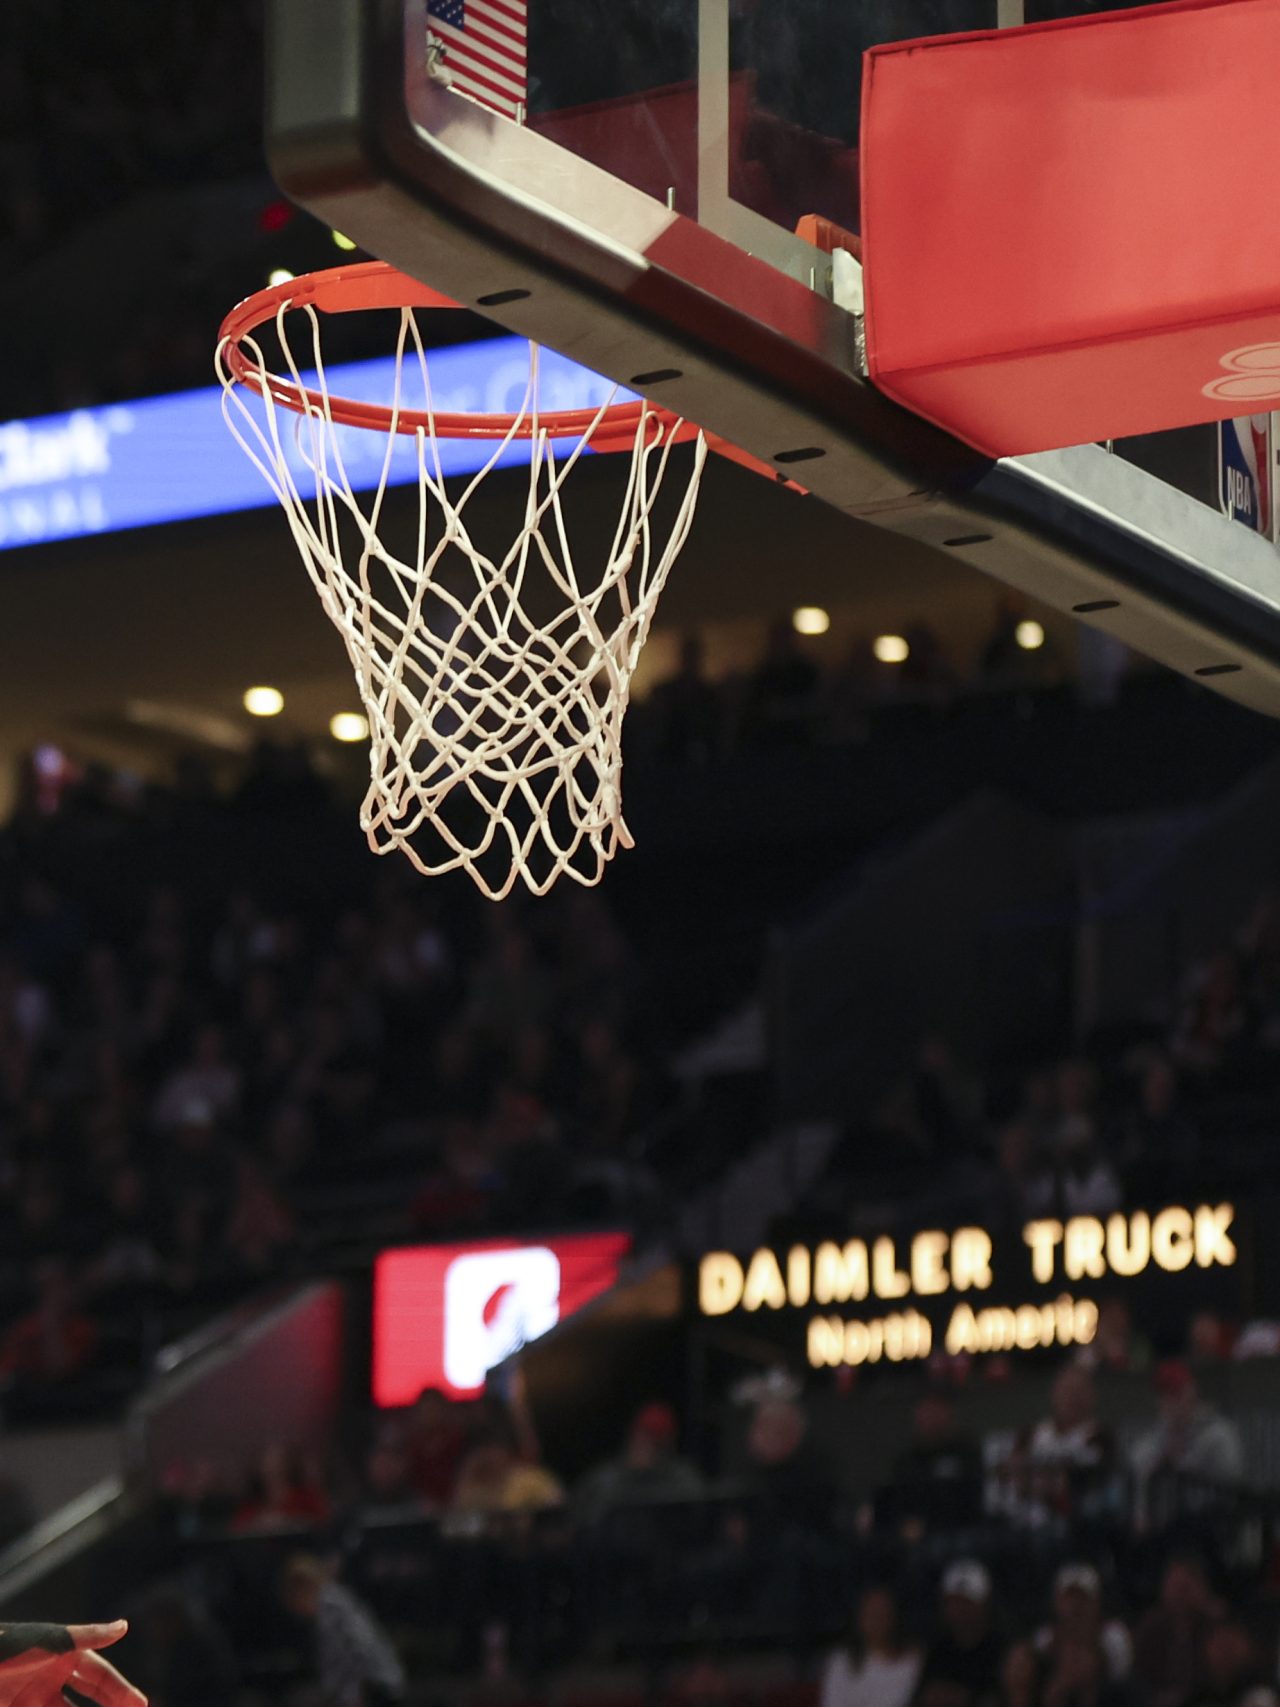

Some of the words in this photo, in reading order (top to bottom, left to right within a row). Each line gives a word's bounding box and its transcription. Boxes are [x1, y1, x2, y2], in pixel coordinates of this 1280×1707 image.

[1227, 465, 1252, 516] NBA
[699, 1226, 993, 1316] DAIMLER
[1024, 1201, 1237, 1283] TRUCK
[807, 1309, 932, 1368] North
